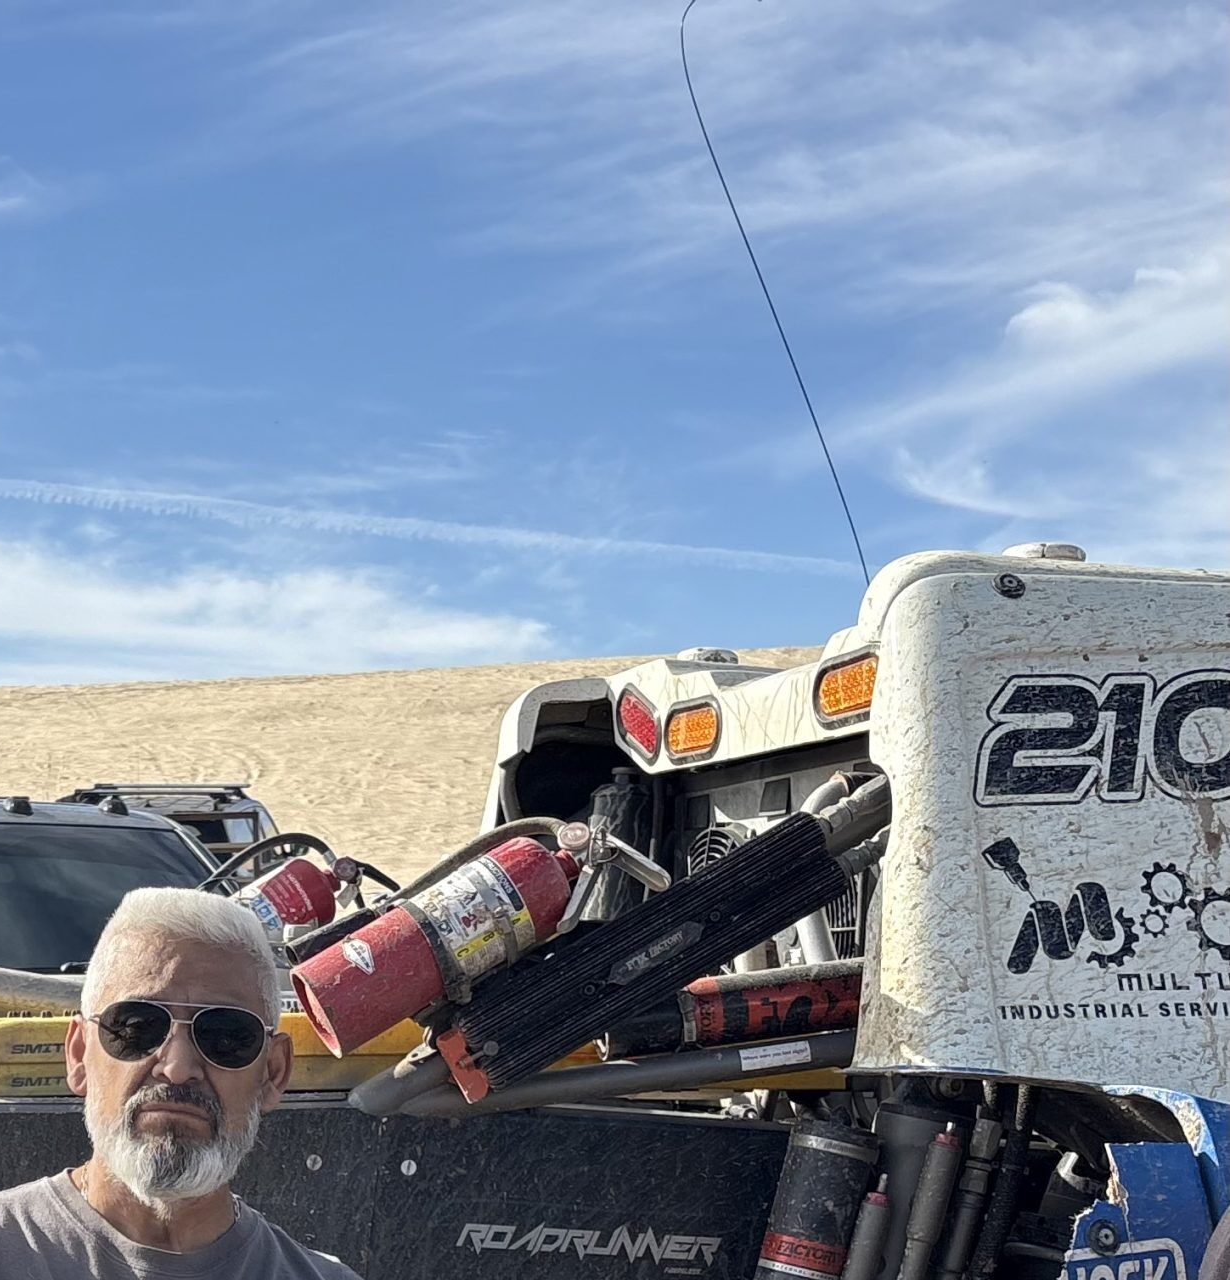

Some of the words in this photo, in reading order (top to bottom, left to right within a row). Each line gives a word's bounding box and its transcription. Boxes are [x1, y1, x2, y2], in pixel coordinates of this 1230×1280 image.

[973, 669, 1230, 807] 210
[998, 1003, 1149, 1020] INDUSTRIAL
[1159, 1001, 1230, 1018] SERVI
[456, 1221, 722, 1267] ROADRUNNER
[776, 1240, 841, 1264] FACTORY
